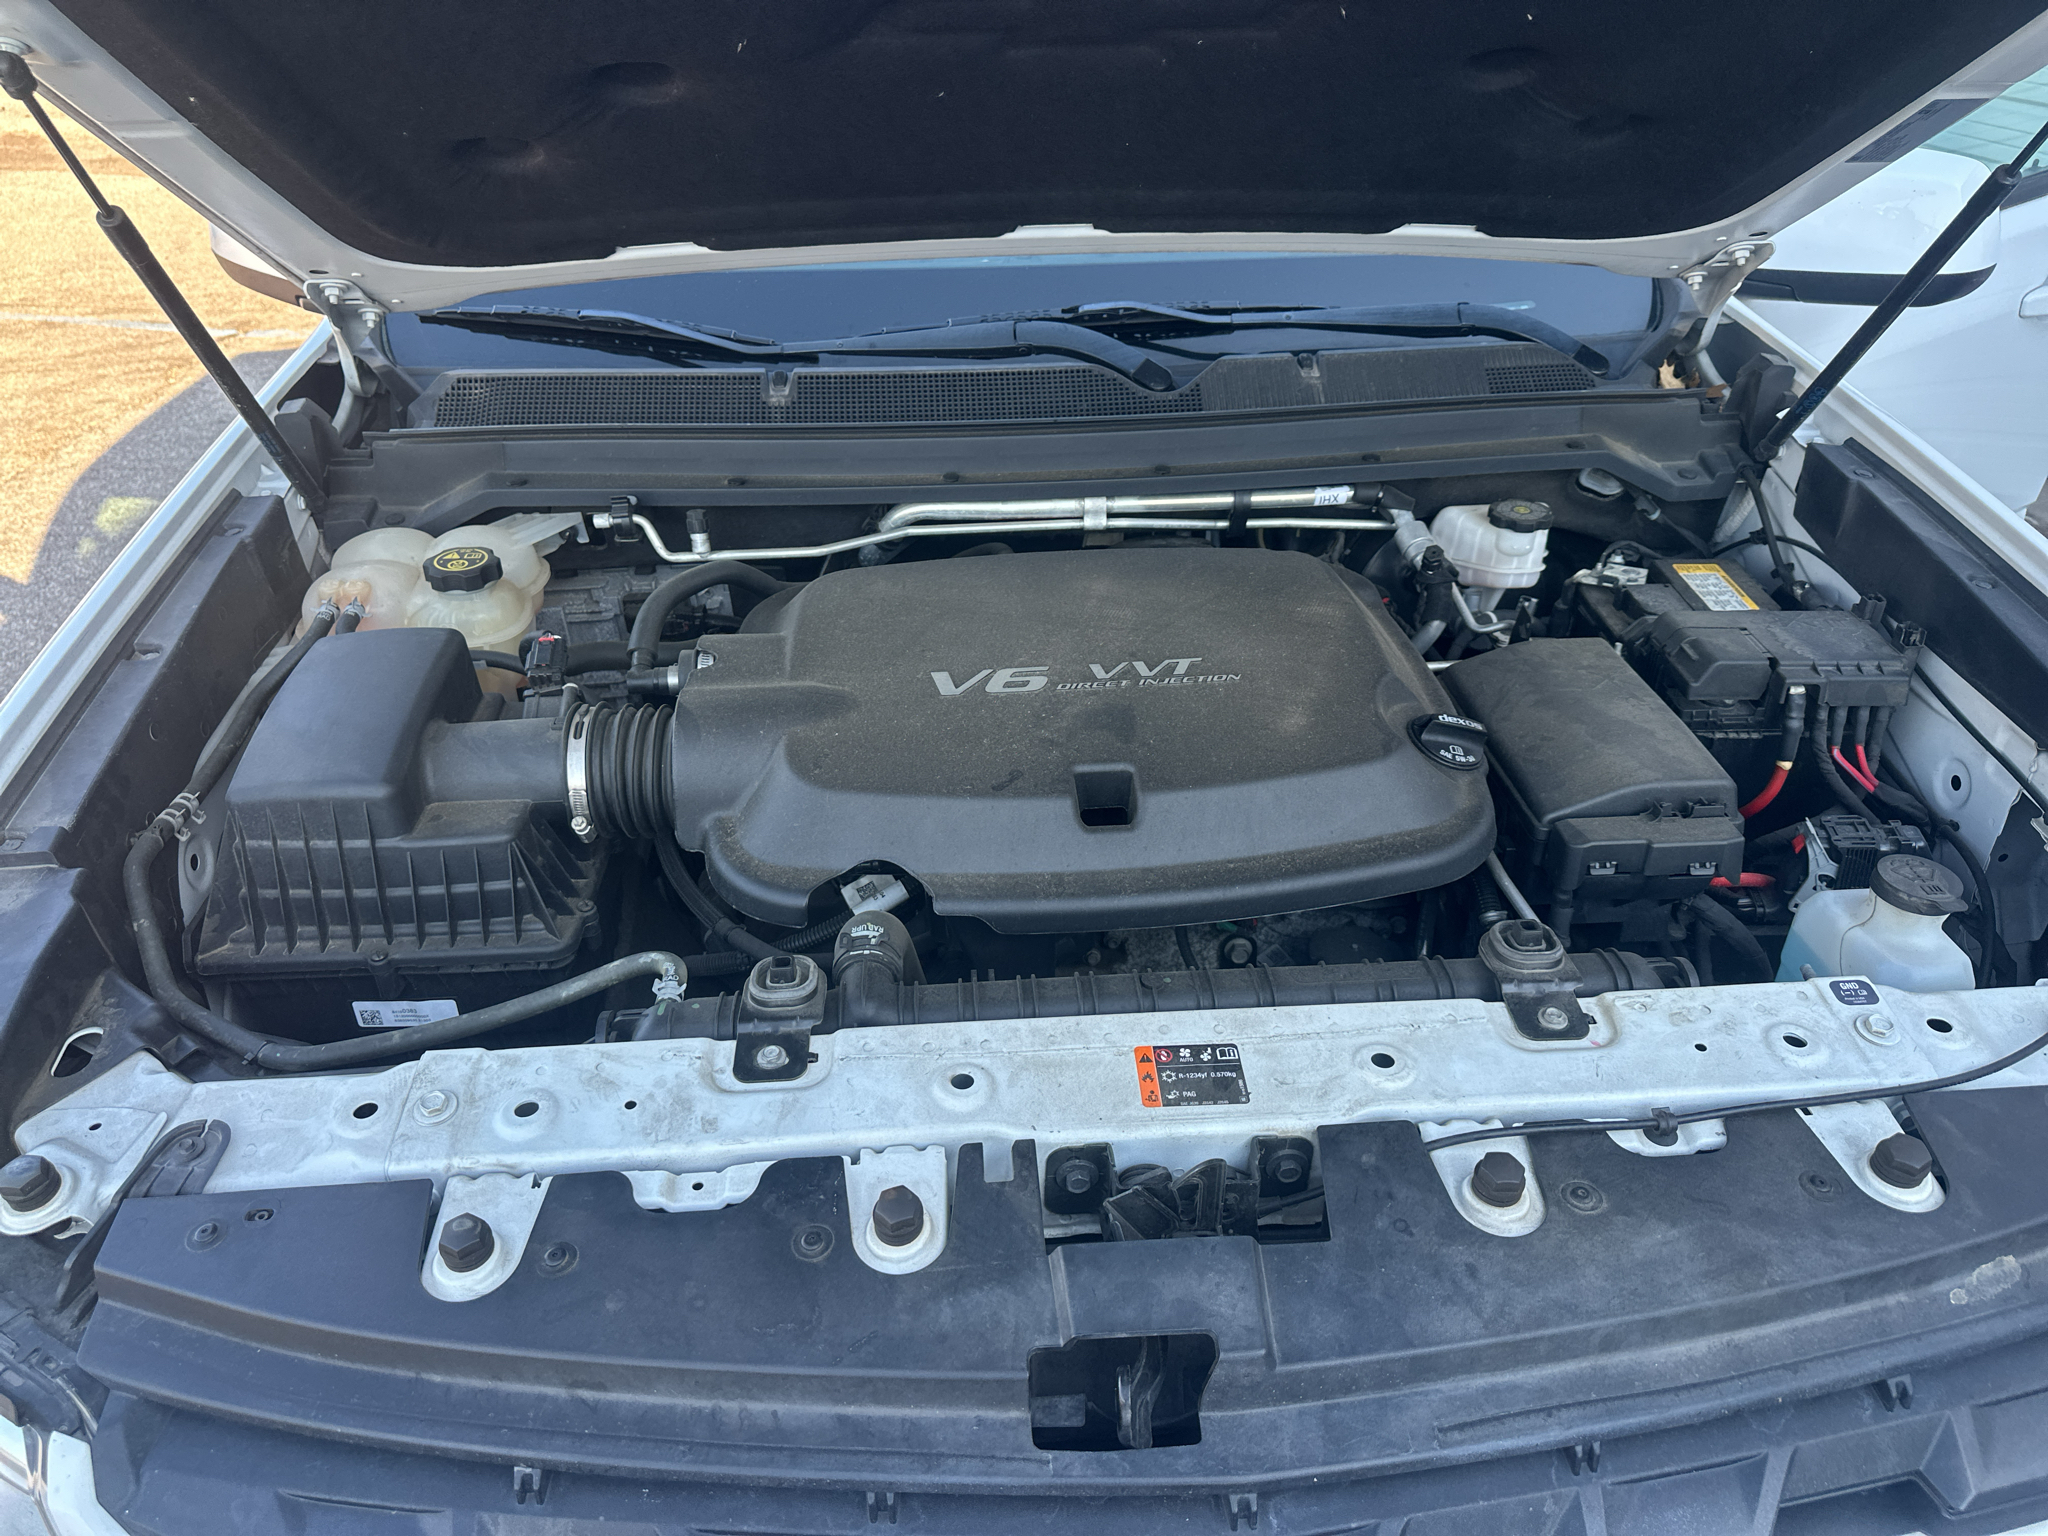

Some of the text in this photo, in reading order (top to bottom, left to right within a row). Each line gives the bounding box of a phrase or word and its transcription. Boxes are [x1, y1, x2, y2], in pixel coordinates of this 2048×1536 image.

[1319, 493, 1339, 504] IHX
[1088, 657, 1203, 679] VVT
[930, 665, 1050, 696] V6
[1056, 673, 1242, 690] DIRECT INJECTION
[1438, 714, 1483, 730] dexos
[1440, 749, 1453, 759] SAE
[851, 923, 884, 933] RAD UPR
